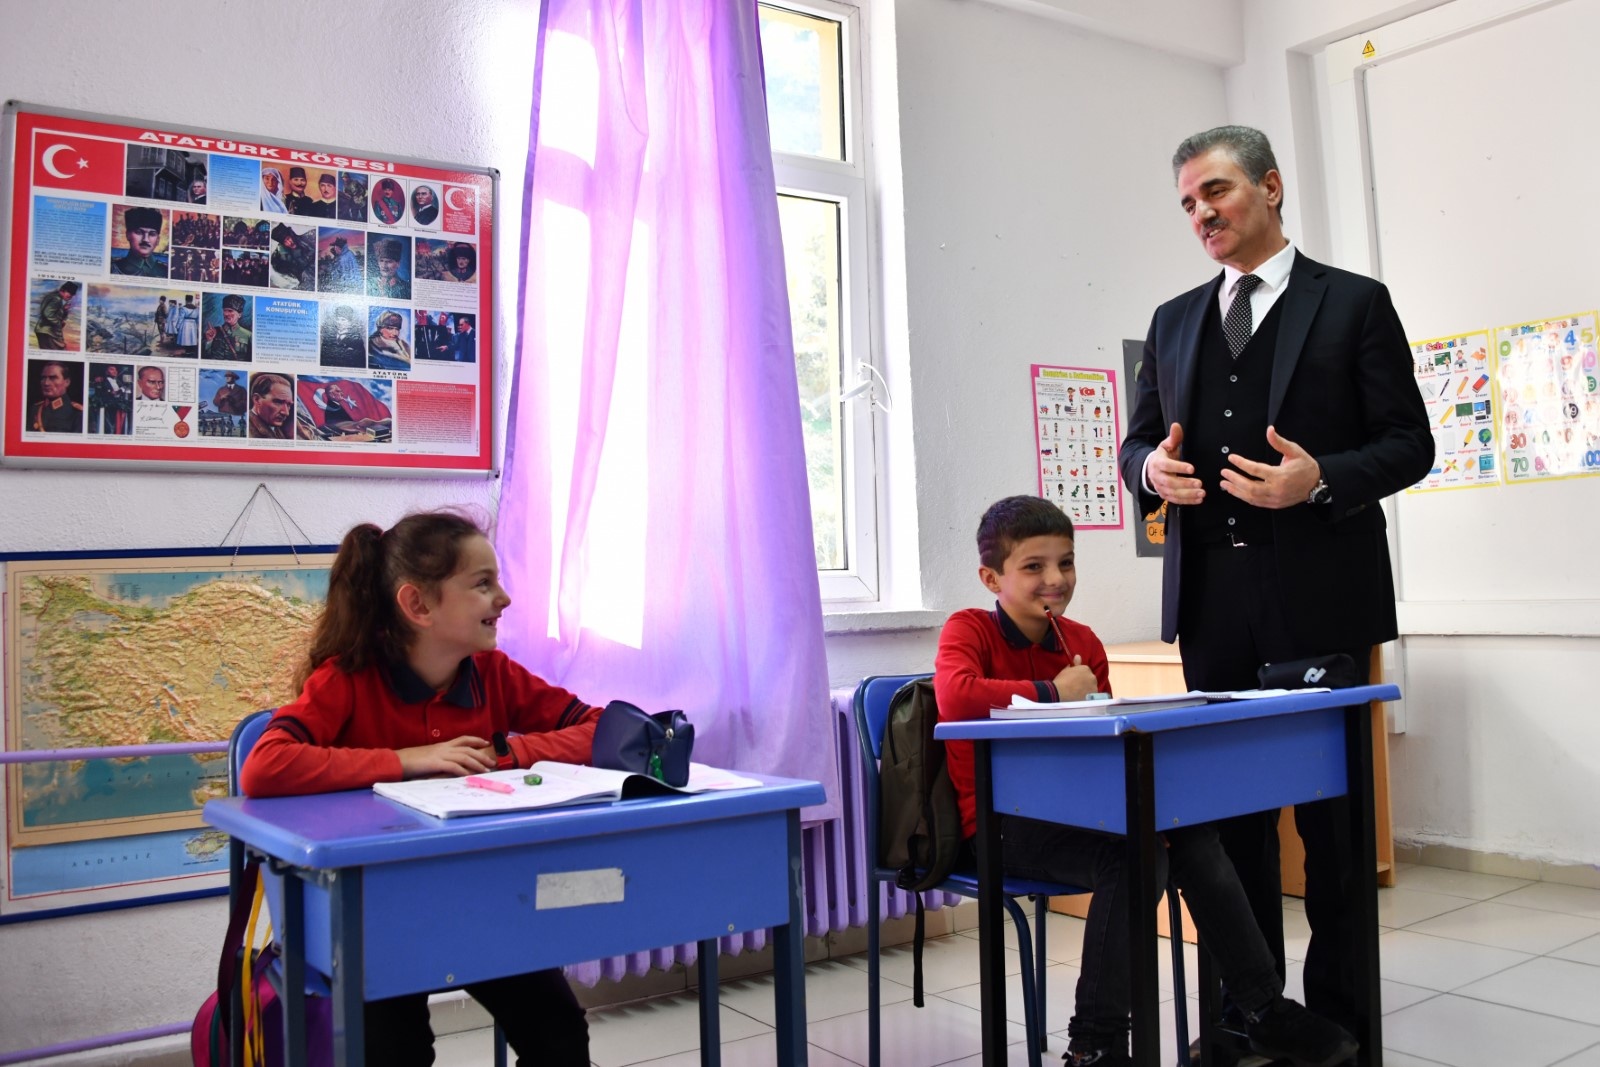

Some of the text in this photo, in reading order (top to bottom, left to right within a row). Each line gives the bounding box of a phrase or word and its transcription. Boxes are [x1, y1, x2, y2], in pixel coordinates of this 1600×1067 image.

[138, 131, 395, 173] ATATÜRK KÖŞESİ
[1425, 338, 1458, 352] School
[1564, 327, 1594, 346] 4 5
[1510, 432, 1527, 450] 30
[1511, 456, 1530, 473] 70
